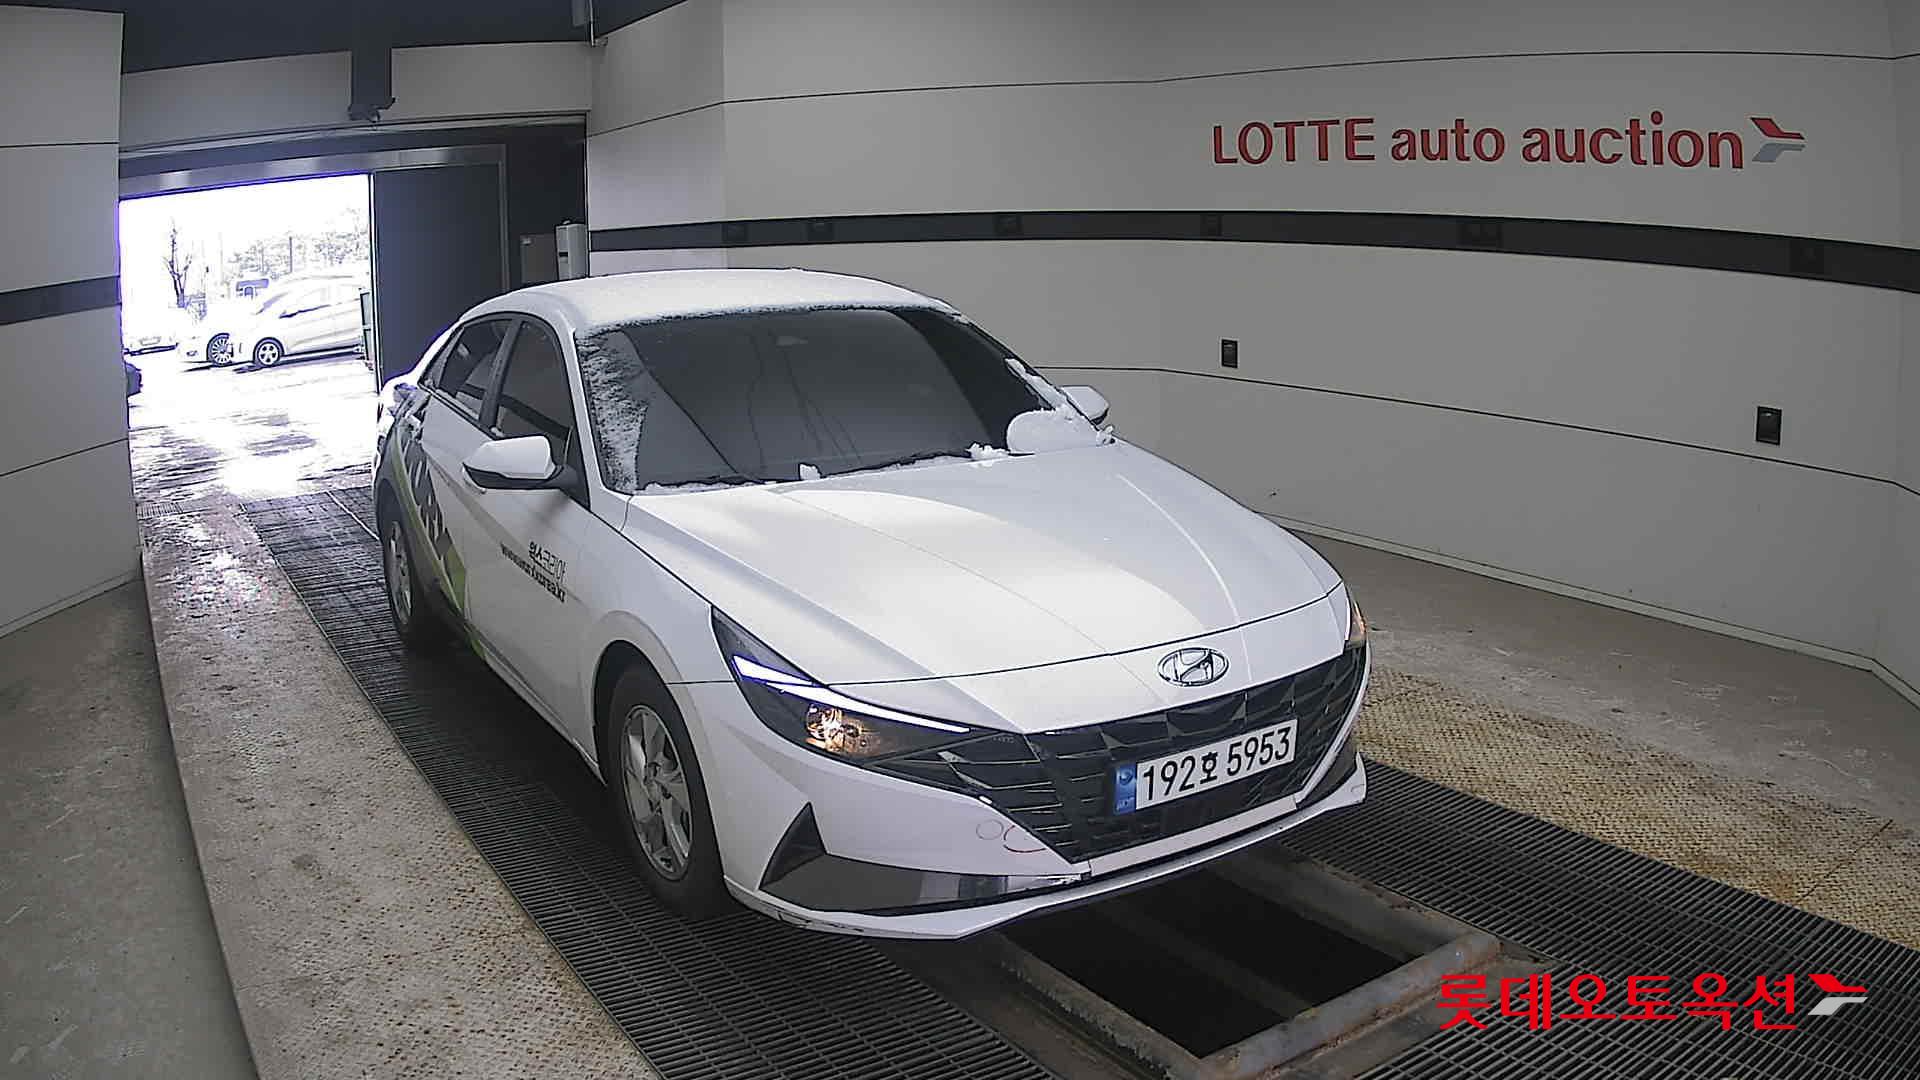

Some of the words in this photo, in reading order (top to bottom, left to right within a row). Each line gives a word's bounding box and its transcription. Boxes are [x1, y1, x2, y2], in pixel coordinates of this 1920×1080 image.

[1213, 118, 1375, 165] LOTTE
[1391, 118, 1505, 162] auto
[1522, 111, 1744, 169] auction
[1143, 752, 1218, 801] 192호
[1227, 727, 1291, 776] 5953
